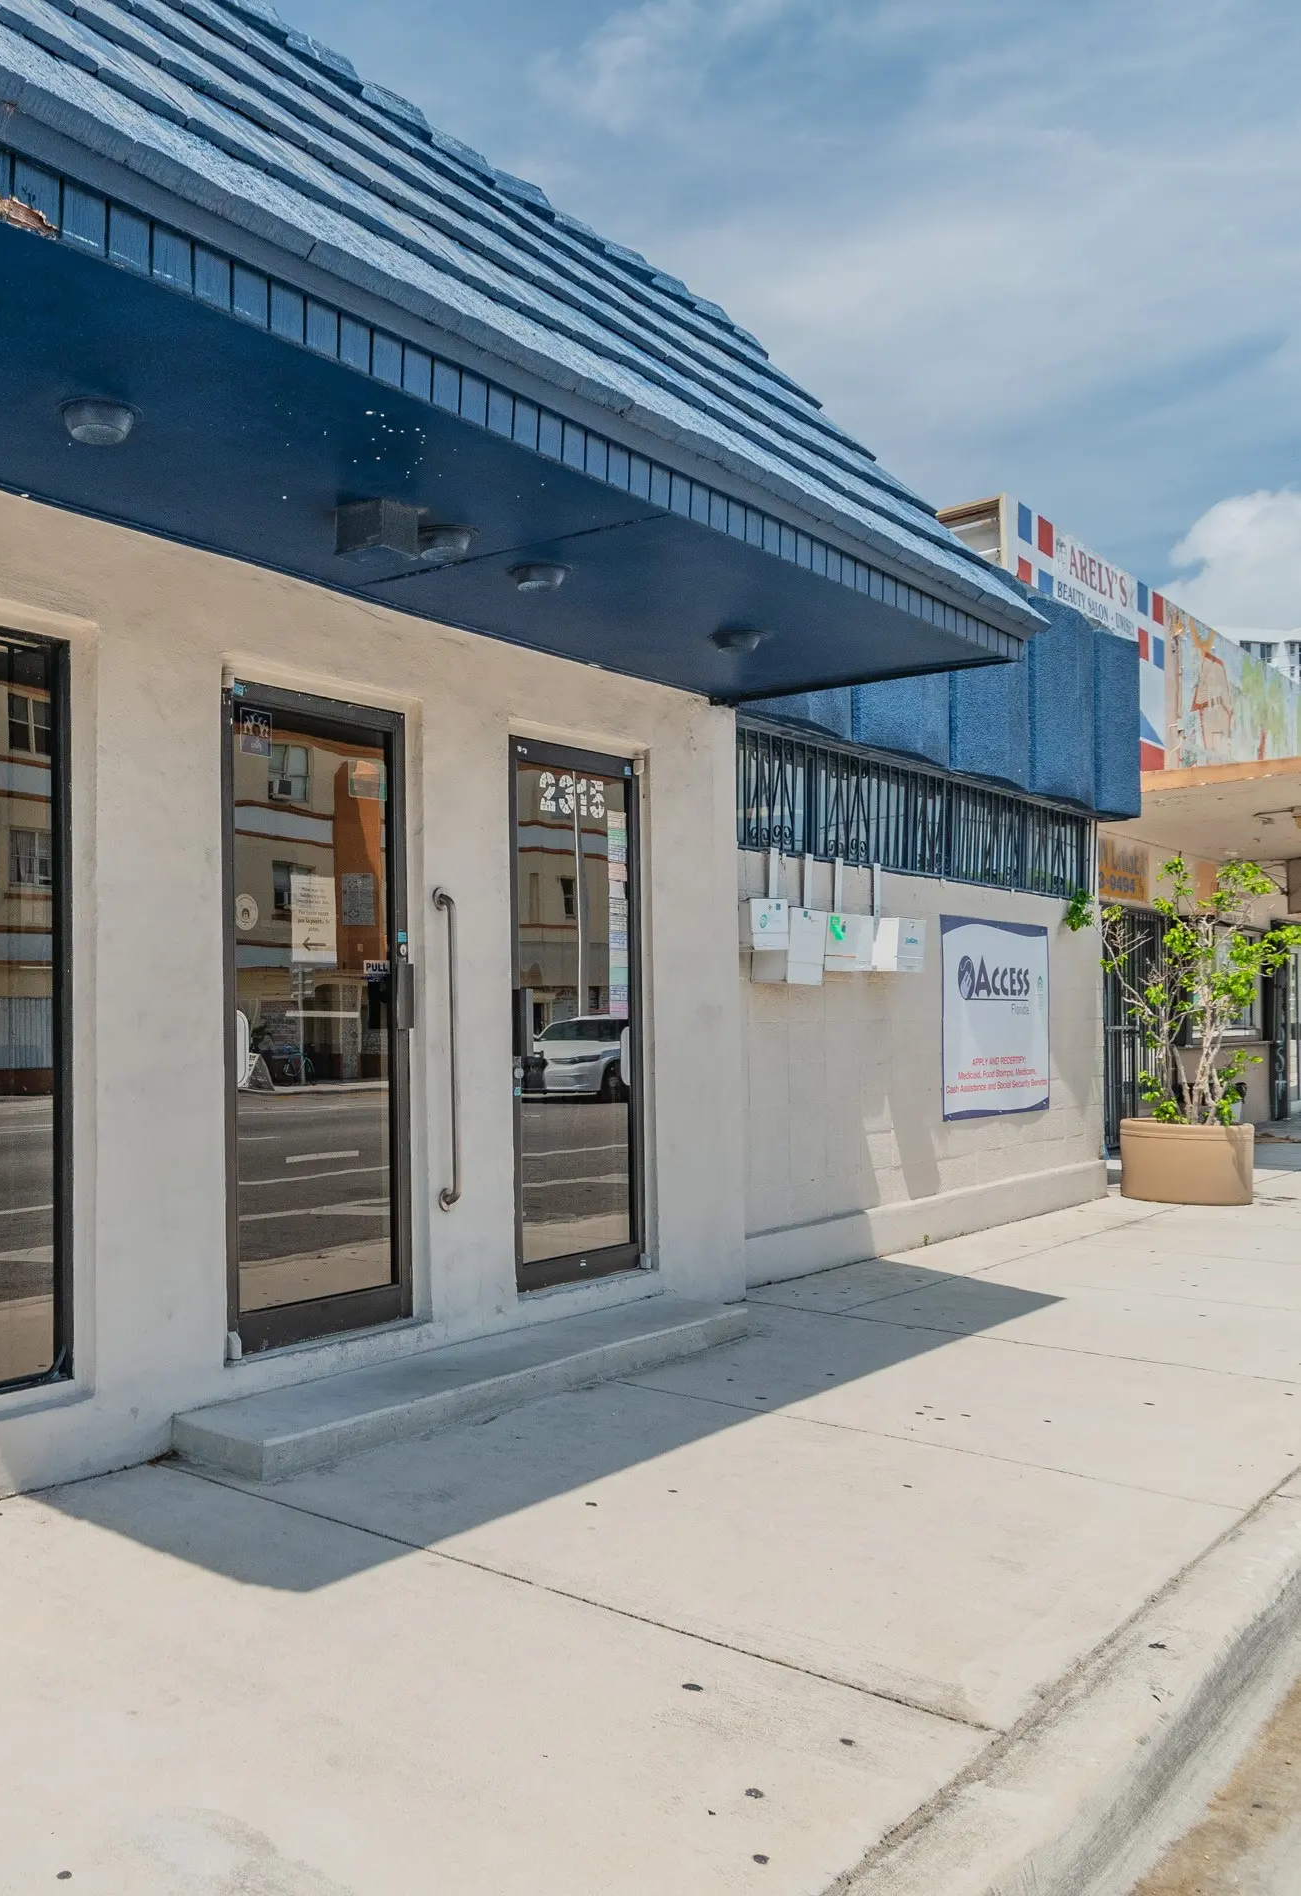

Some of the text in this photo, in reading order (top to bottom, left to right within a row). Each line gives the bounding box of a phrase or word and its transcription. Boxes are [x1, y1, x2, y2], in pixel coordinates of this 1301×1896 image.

[1069, 545, 1128, 608] ARELY'S
[1057, 581, 1087, 610] BEAUTY
[1087, 597, 1109, 622] SALON
[365, 962, 387, 972] PULL
[972, 1057, 988, 1067] APPLY
[989, 1056, 1000, 1066] AND
[982, 1070, 995, 1079] Food
[946, 1085, 959, 1095] Cash
[959, 1084, 987, 1093] Assistance
[987, 1083, 996, 1091] and
[1011, 1079, 1031, 1089] Security
